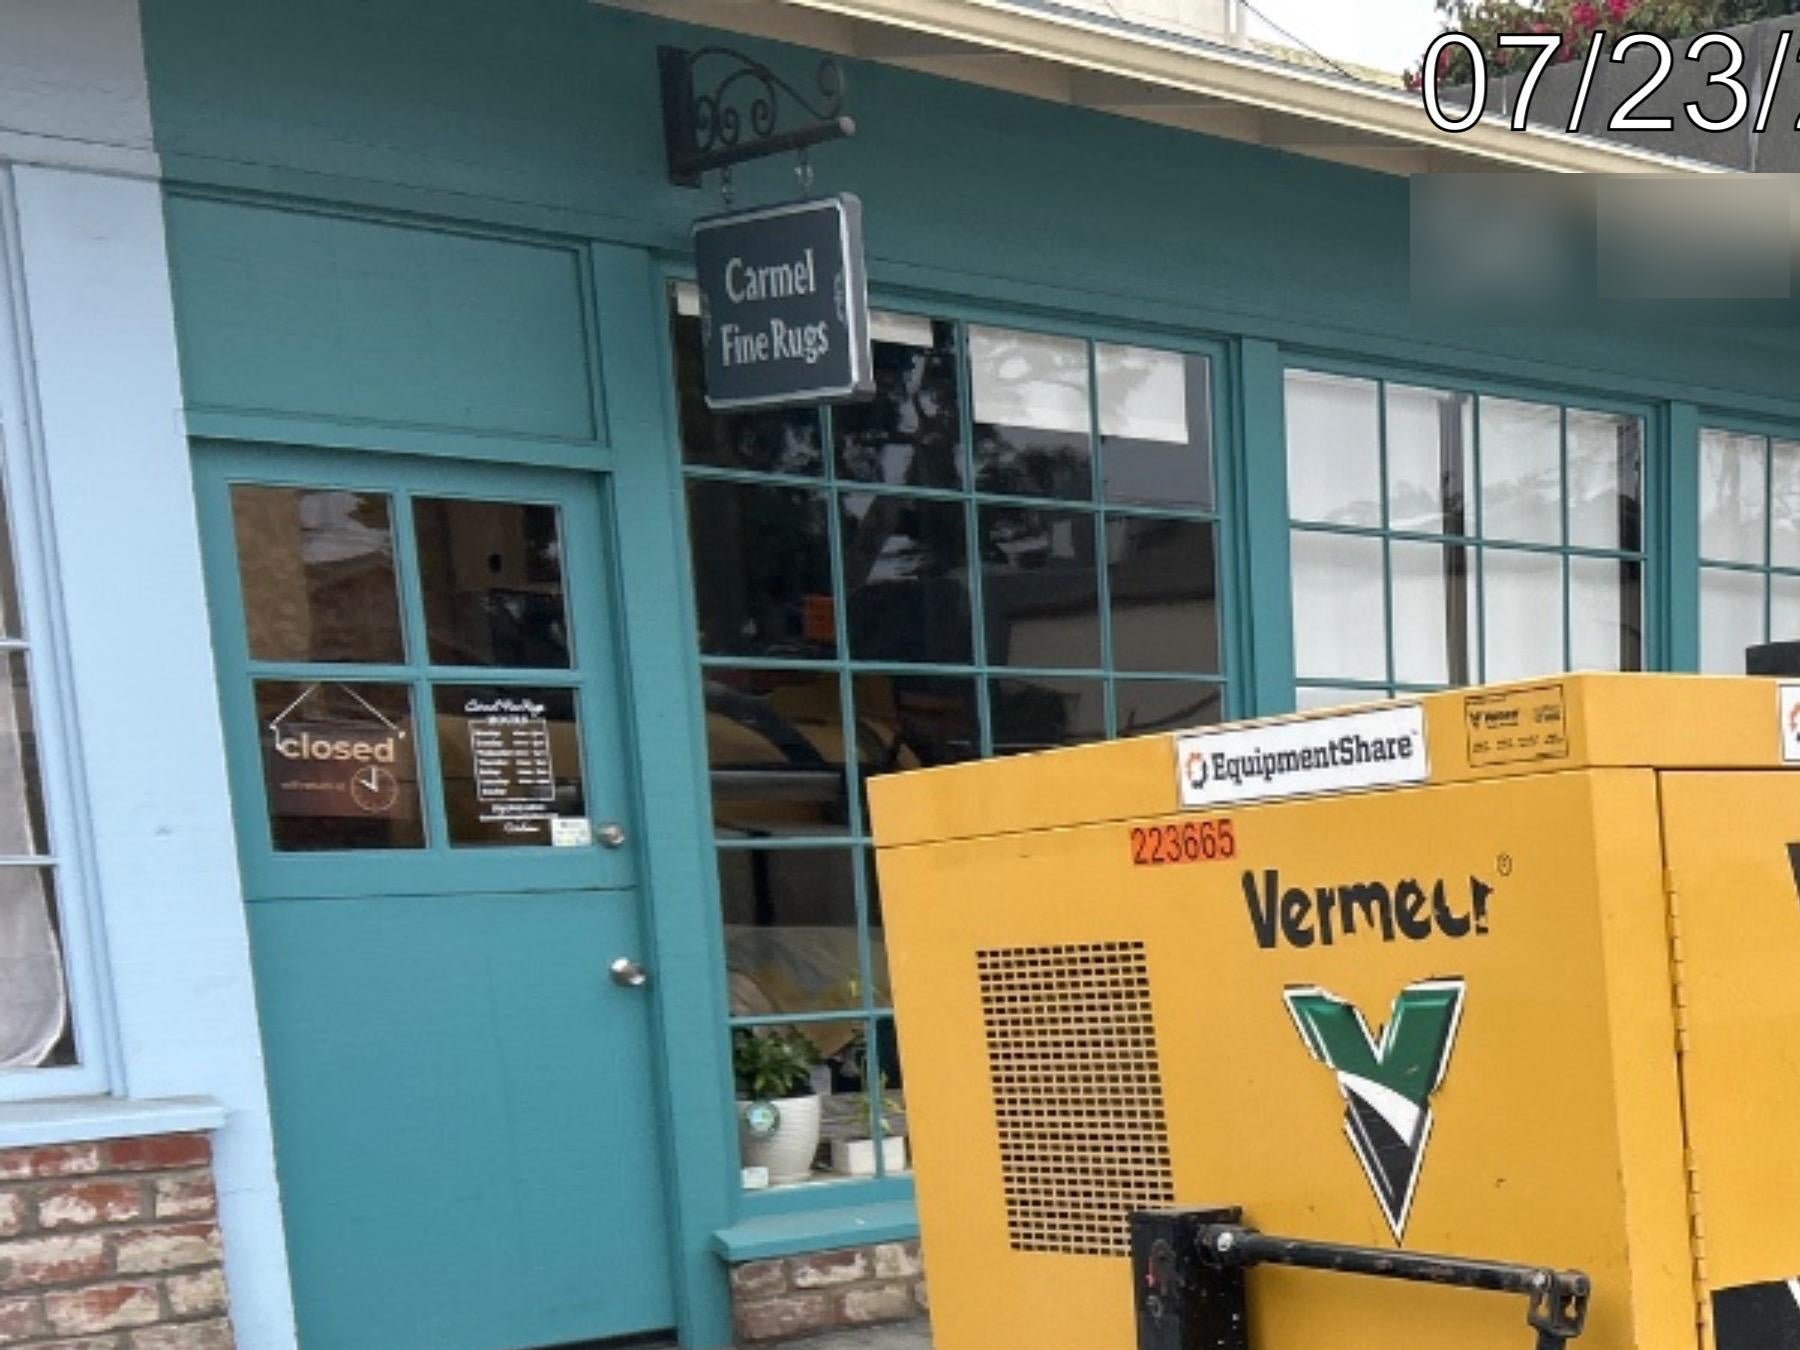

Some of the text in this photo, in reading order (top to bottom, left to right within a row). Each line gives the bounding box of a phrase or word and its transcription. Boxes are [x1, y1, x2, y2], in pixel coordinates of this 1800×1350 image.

[725, 248, 816, 303] Carmel
[720, 317, 830, 367] Fine Rugs
[279, 731, 395, 763] closed
[1211, 734, 1414, 781] EquipmentShare
[1132, 820, 1236, 865] 223665
